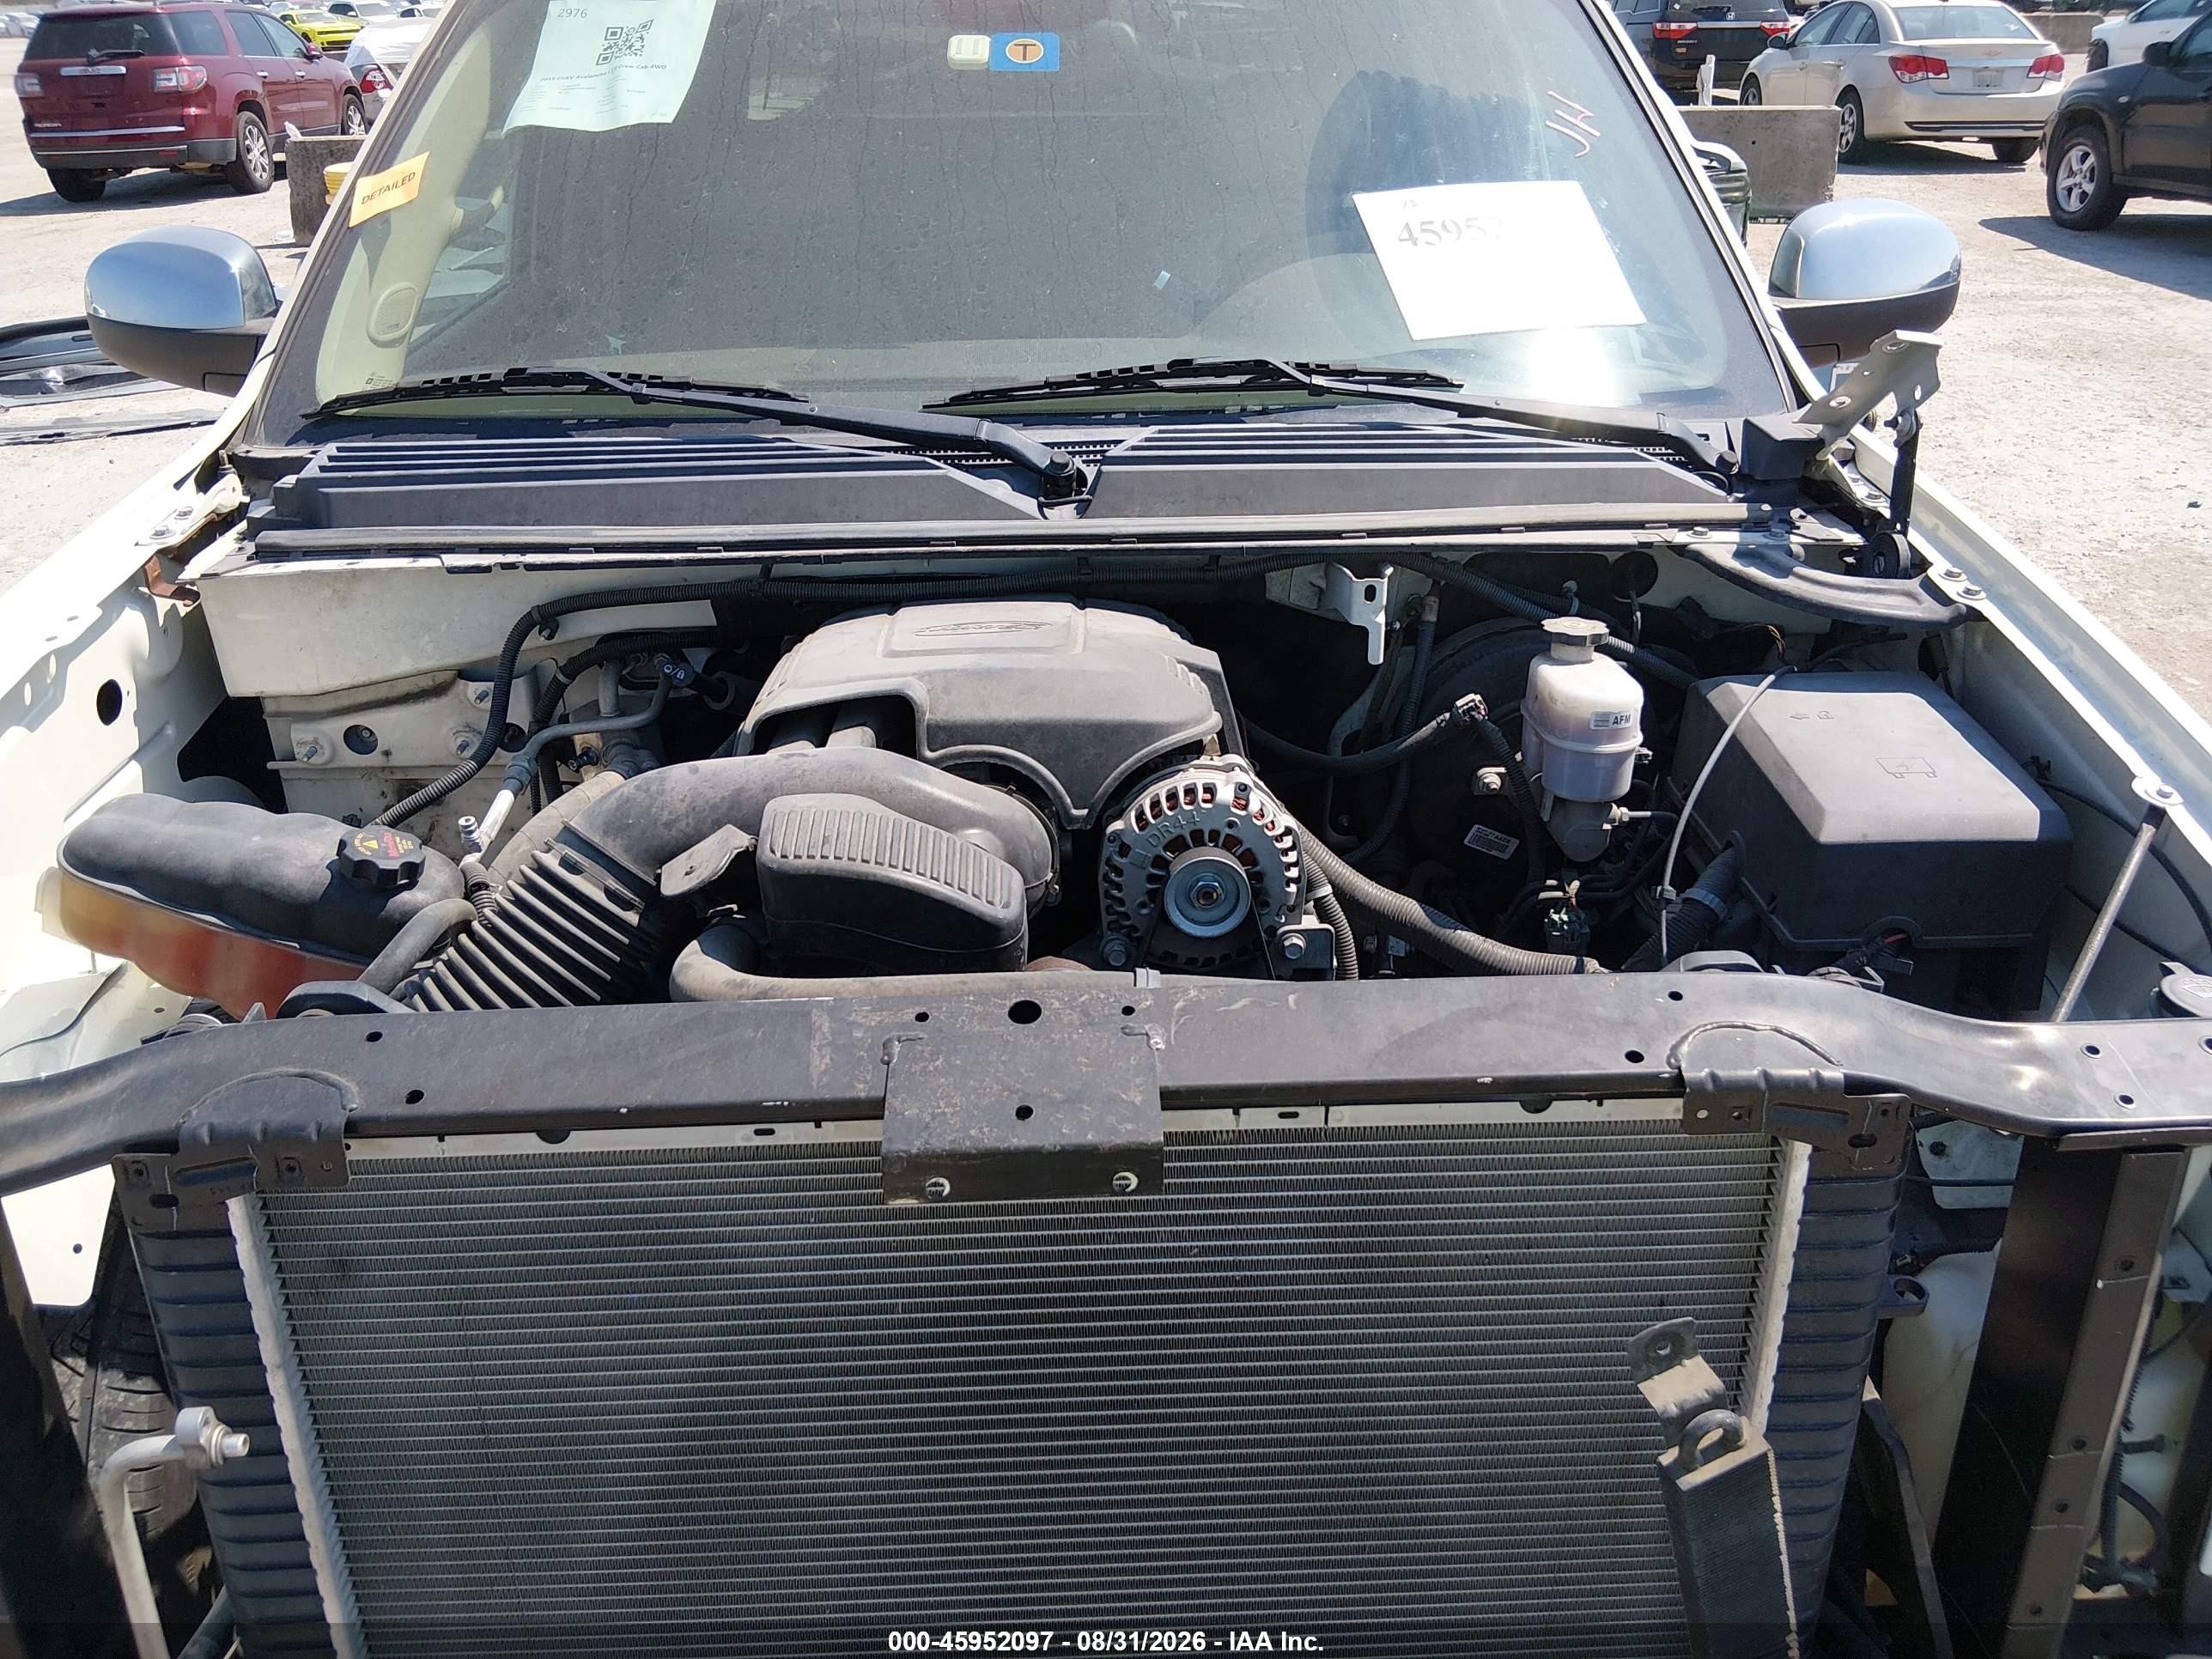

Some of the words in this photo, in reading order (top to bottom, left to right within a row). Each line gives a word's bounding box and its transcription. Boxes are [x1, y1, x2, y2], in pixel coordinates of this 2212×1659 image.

[556, 8, 588, 19] 2976
[1014, 43, 1036, 61] T
[362, 172, 416, 204] DETAILED
[1612, 714, 1631, 726] AFM
